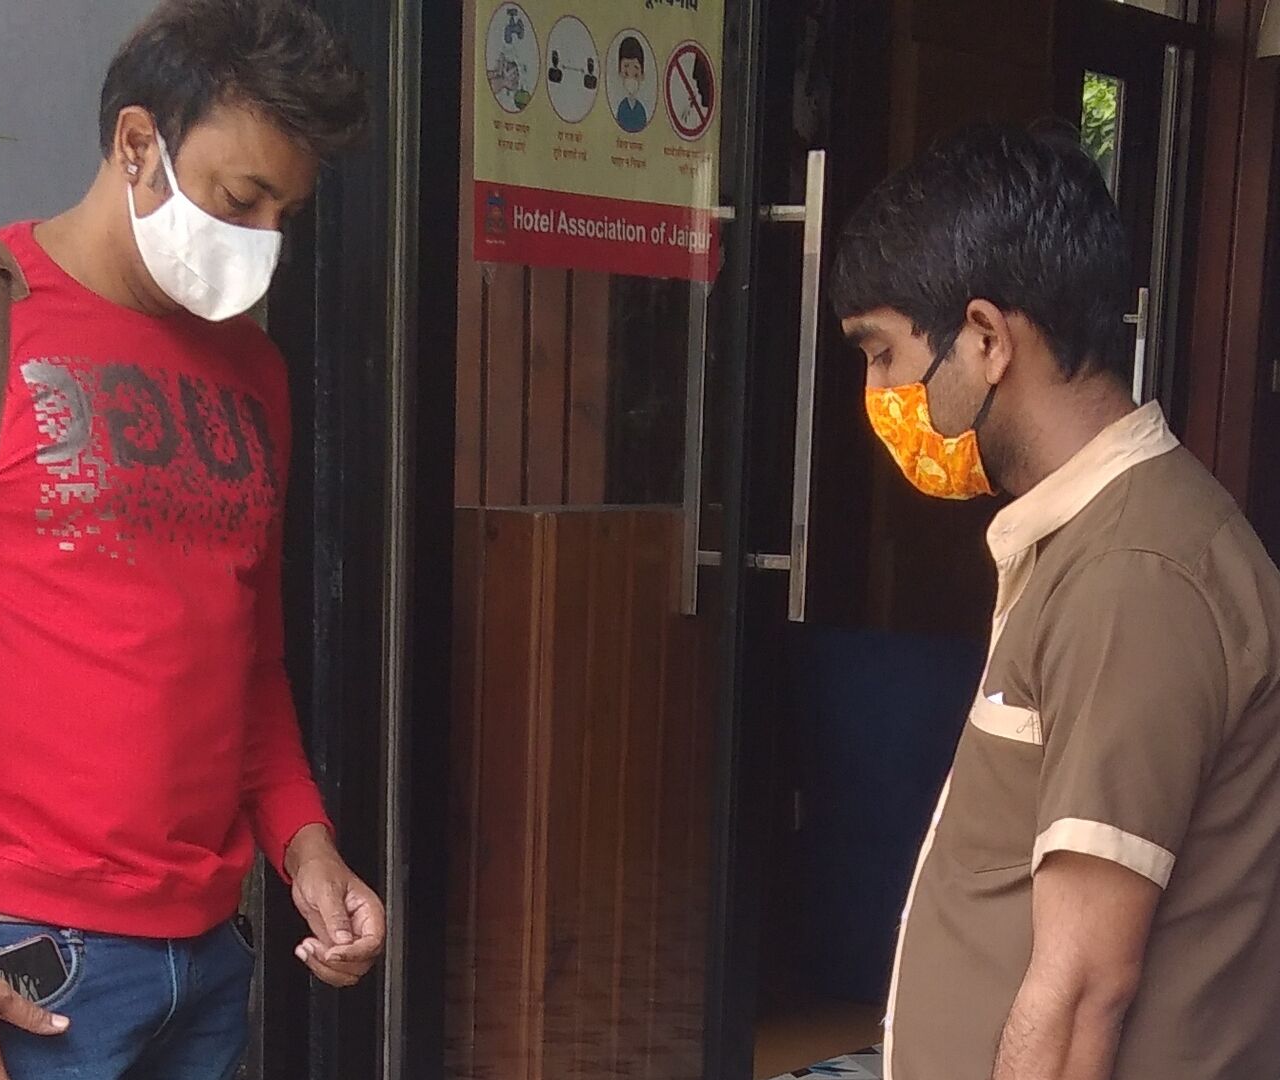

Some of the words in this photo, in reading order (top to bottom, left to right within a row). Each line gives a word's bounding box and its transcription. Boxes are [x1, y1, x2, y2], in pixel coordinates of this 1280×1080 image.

[513, 205, 554, 233] Hotel
[557, 210, 645, 243] Association
[651, 221, 666, 244] of
[669, 224, 712, 254] Jaipur
